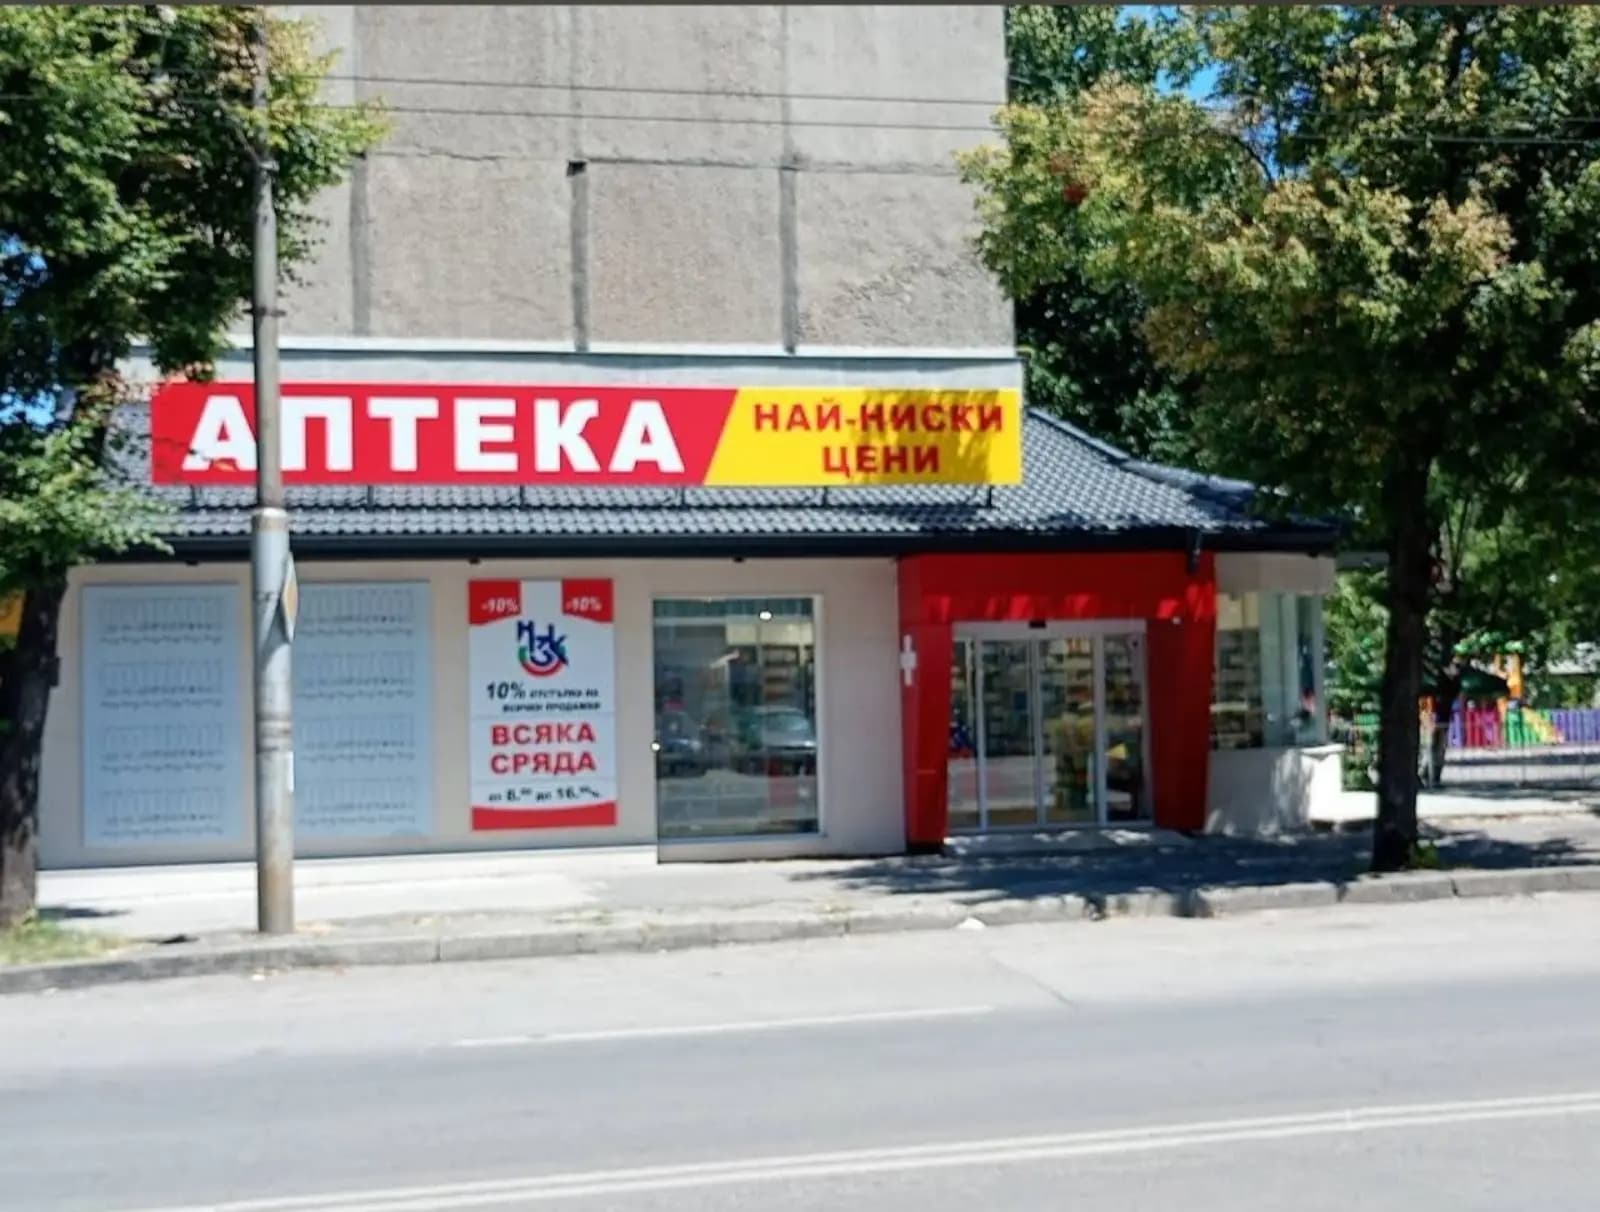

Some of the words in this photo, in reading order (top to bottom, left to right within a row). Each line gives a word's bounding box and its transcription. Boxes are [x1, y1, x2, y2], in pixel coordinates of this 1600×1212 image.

[753, 397, 1003, 432] НАЙ-НИСКИ
[182, 395, 685, 473] АПТЕКА
[821, 445, 940, 478] ЦЕНИ
[481, 597, 519, 613] -10%
[565, 596, 602, 612] -10%
[486, 681, 526, 700] 10%
[491, 722, 596, 746] ВСЯКА
[490, 750, 597, 776] СРЯДА
